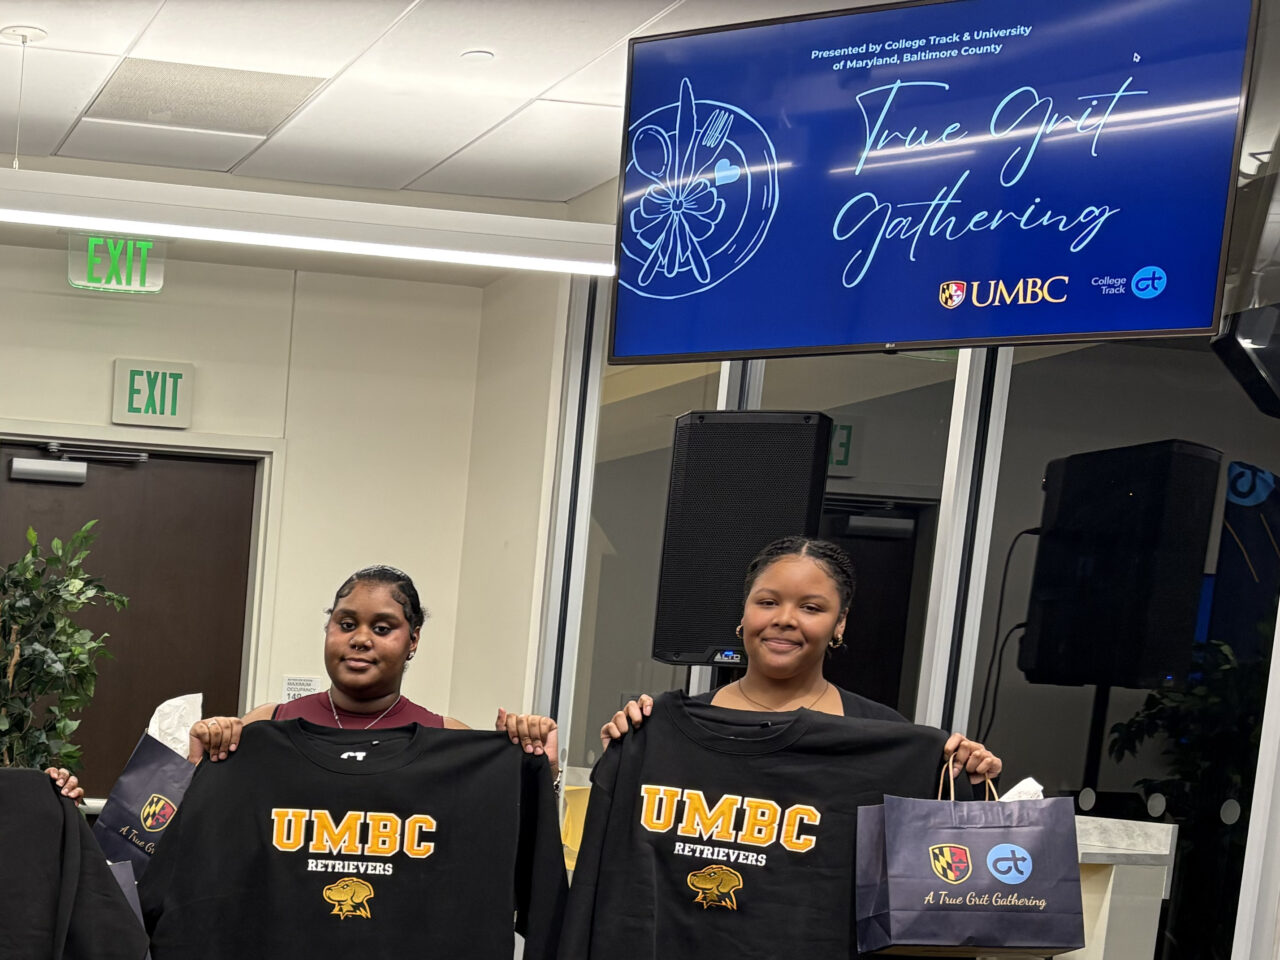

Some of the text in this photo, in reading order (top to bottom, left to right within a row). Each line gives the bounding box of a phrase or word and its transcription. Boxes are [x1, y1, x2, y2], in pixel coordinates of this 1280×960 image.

[811, 25, 1033, 59] Presented by College Track & University
[832, 43, 1003, 71] of Maryland, Baltimore County
[855, 77, 1148, 187] True Grit
[833, 170, 1120, 288] Gathering
[86, 236, 153, 287] EXIT
[970, 275, 1069, 308] UMBC
[1091, 276, 1127, 287] College
[1100, 284, 1126, 295] Track
[127, 368, 183, 416] EXIT
[271, 808, 437, 859] UMBC
[640, 784, 821, 853] UMBC
[119, 825, 130, 836] A
[128, 829, 145, 847] True
[307, 859, 393, 876] RETRIEVERS
[673, 841, 767, 868] RETRIEVERS
[924, 891, 1048, 910] A True Grit Gathering
